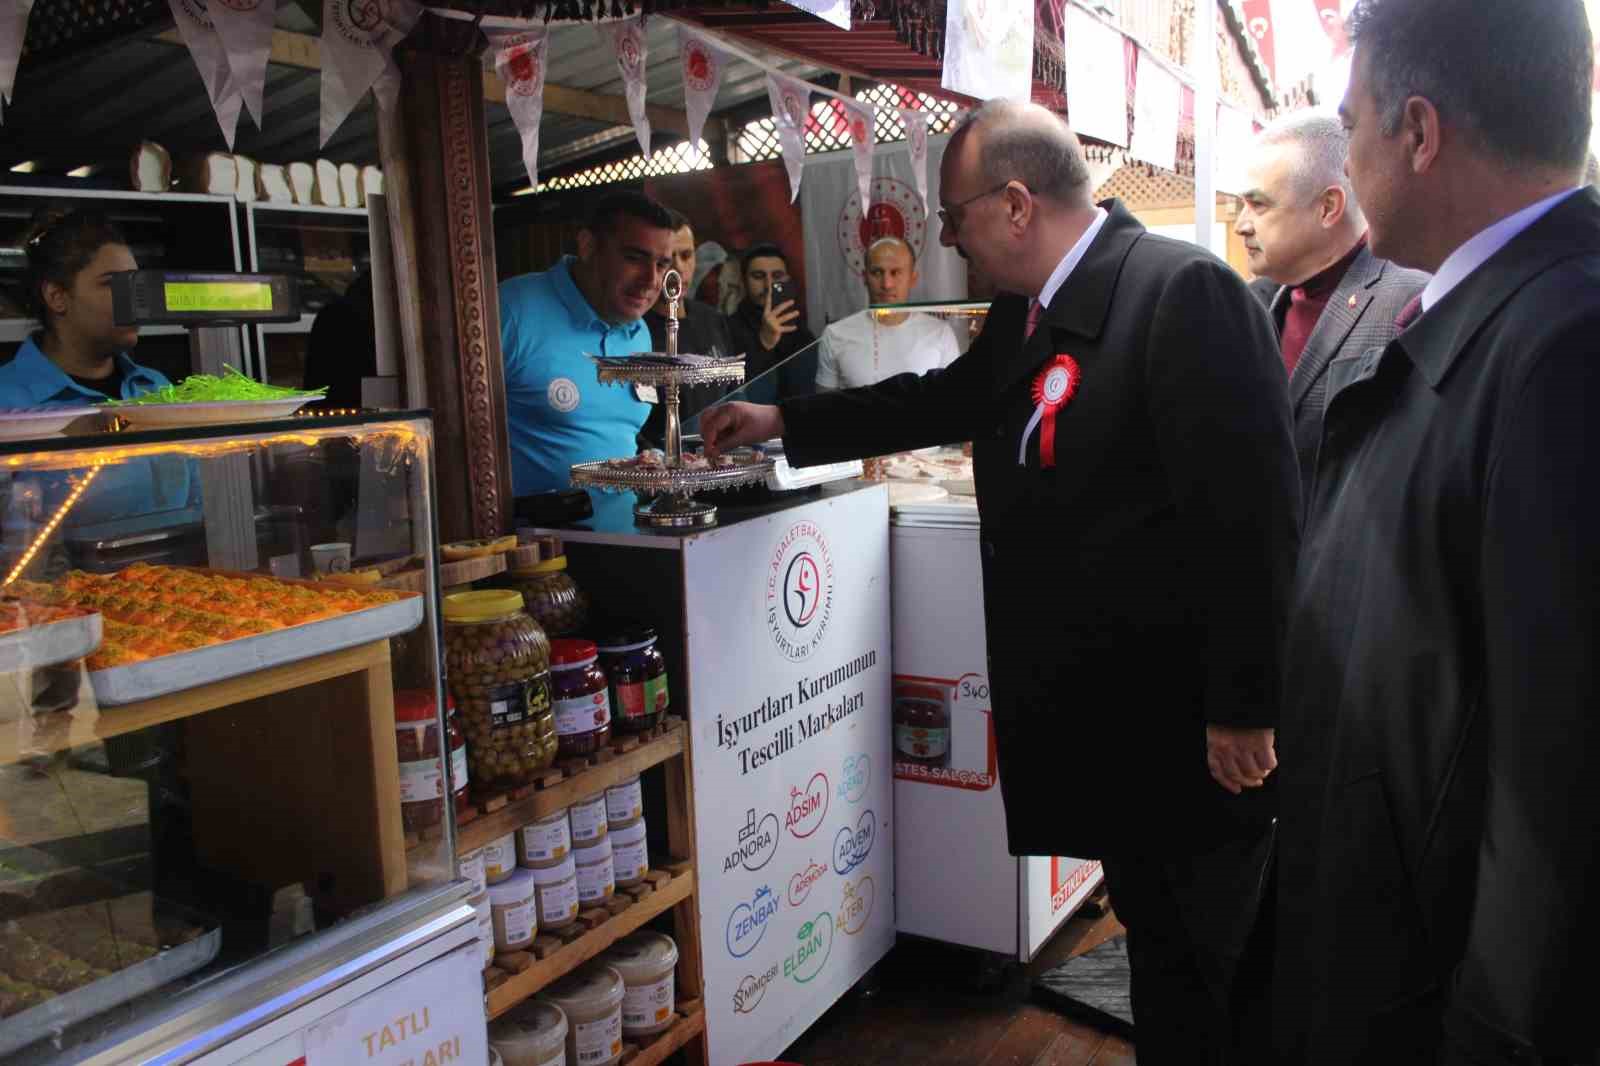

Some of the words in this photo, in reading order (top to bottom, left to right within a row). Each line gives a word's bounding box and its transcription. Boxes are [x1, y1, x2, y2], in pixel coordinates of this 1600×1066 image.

[717, 694, 794, 750] İşyurtları
[797, 649, 877, 704] Kurumunun
[737, 722, 794, 776] Tescilli
[797, 690, 865, 744] Markaları
[722, 830, 773, 873] ADNORA
[839, 823, 872, 860] ADVEM
[735, 895, 781, 942] ZENBAY
[783, 931, 823, 977] ELBAN
[361, 1005, 430, 1058] TATLI
